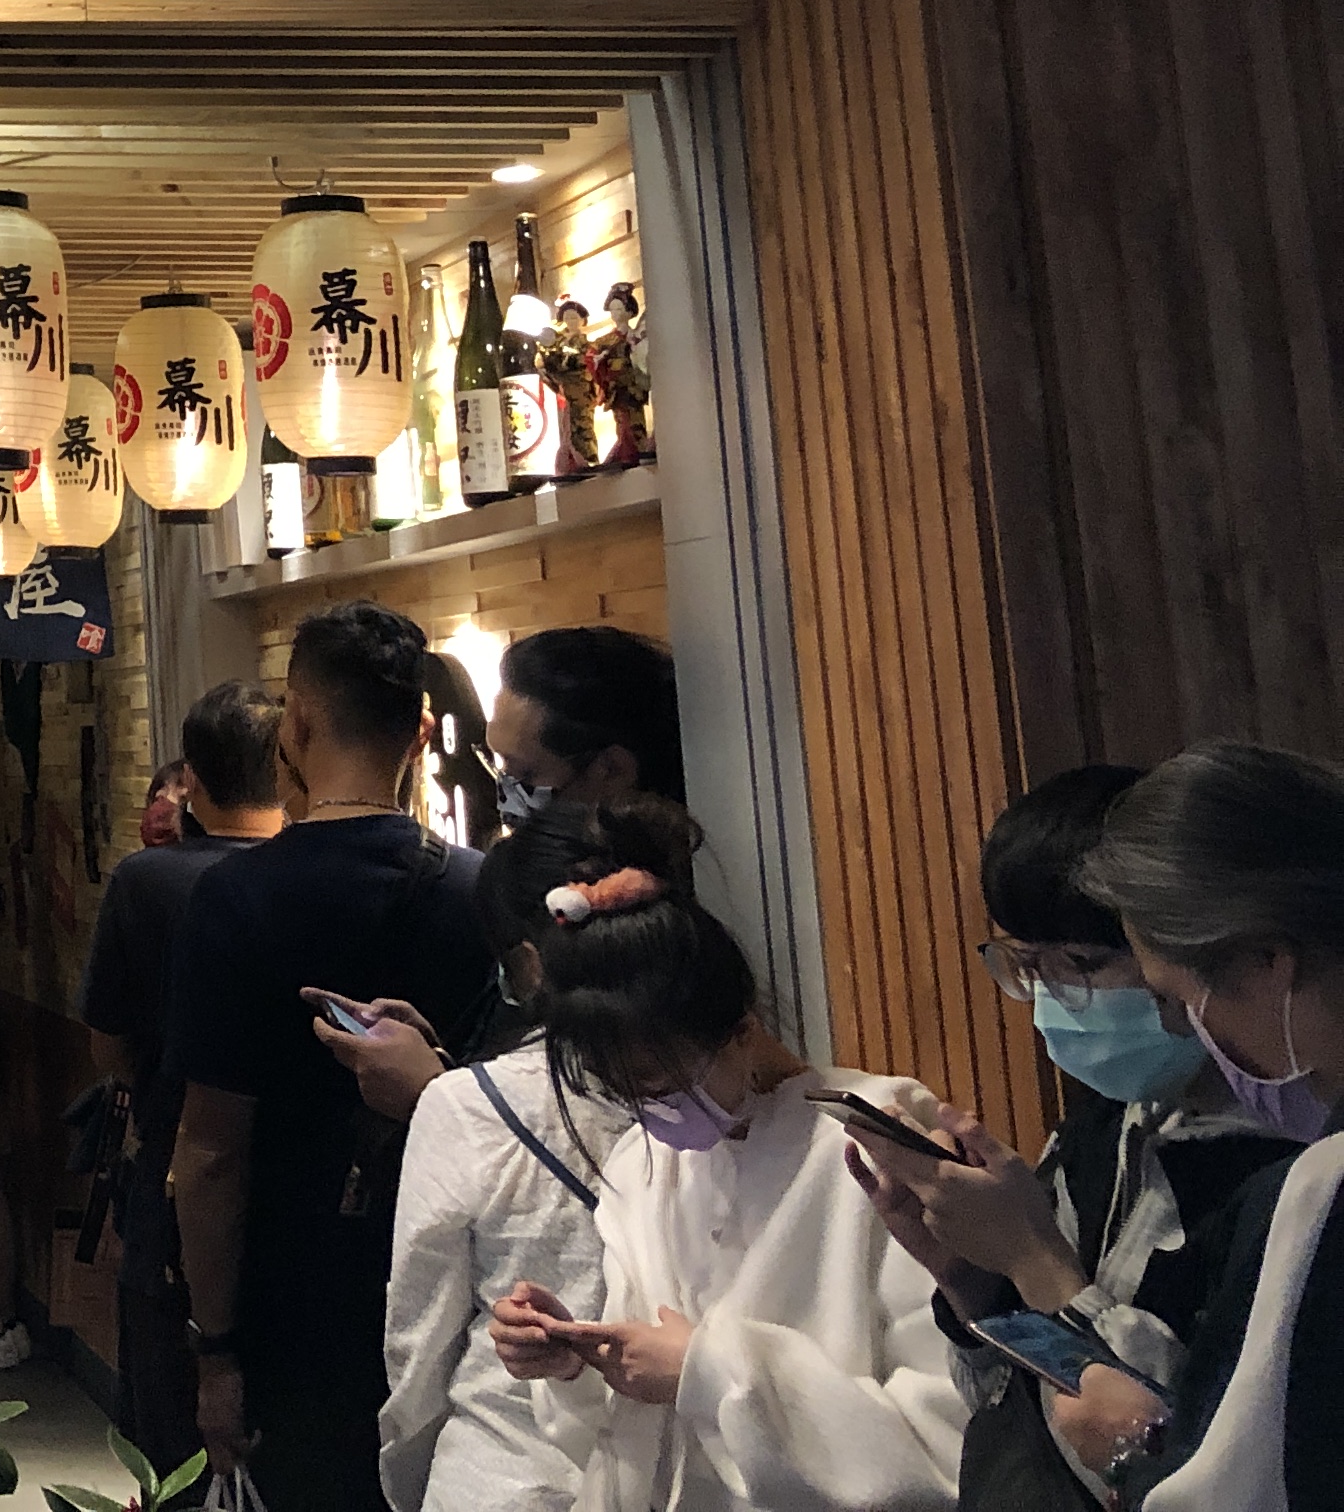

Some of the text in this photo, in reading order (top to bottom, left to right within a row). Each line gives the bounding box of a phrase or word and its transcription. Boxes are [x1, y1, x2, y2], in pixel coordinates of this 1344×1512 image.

[310, 267, 403, 382] 幕川
[156, 357, 235, 451] 幕川
[57, 415, 118, 496] 幕川
